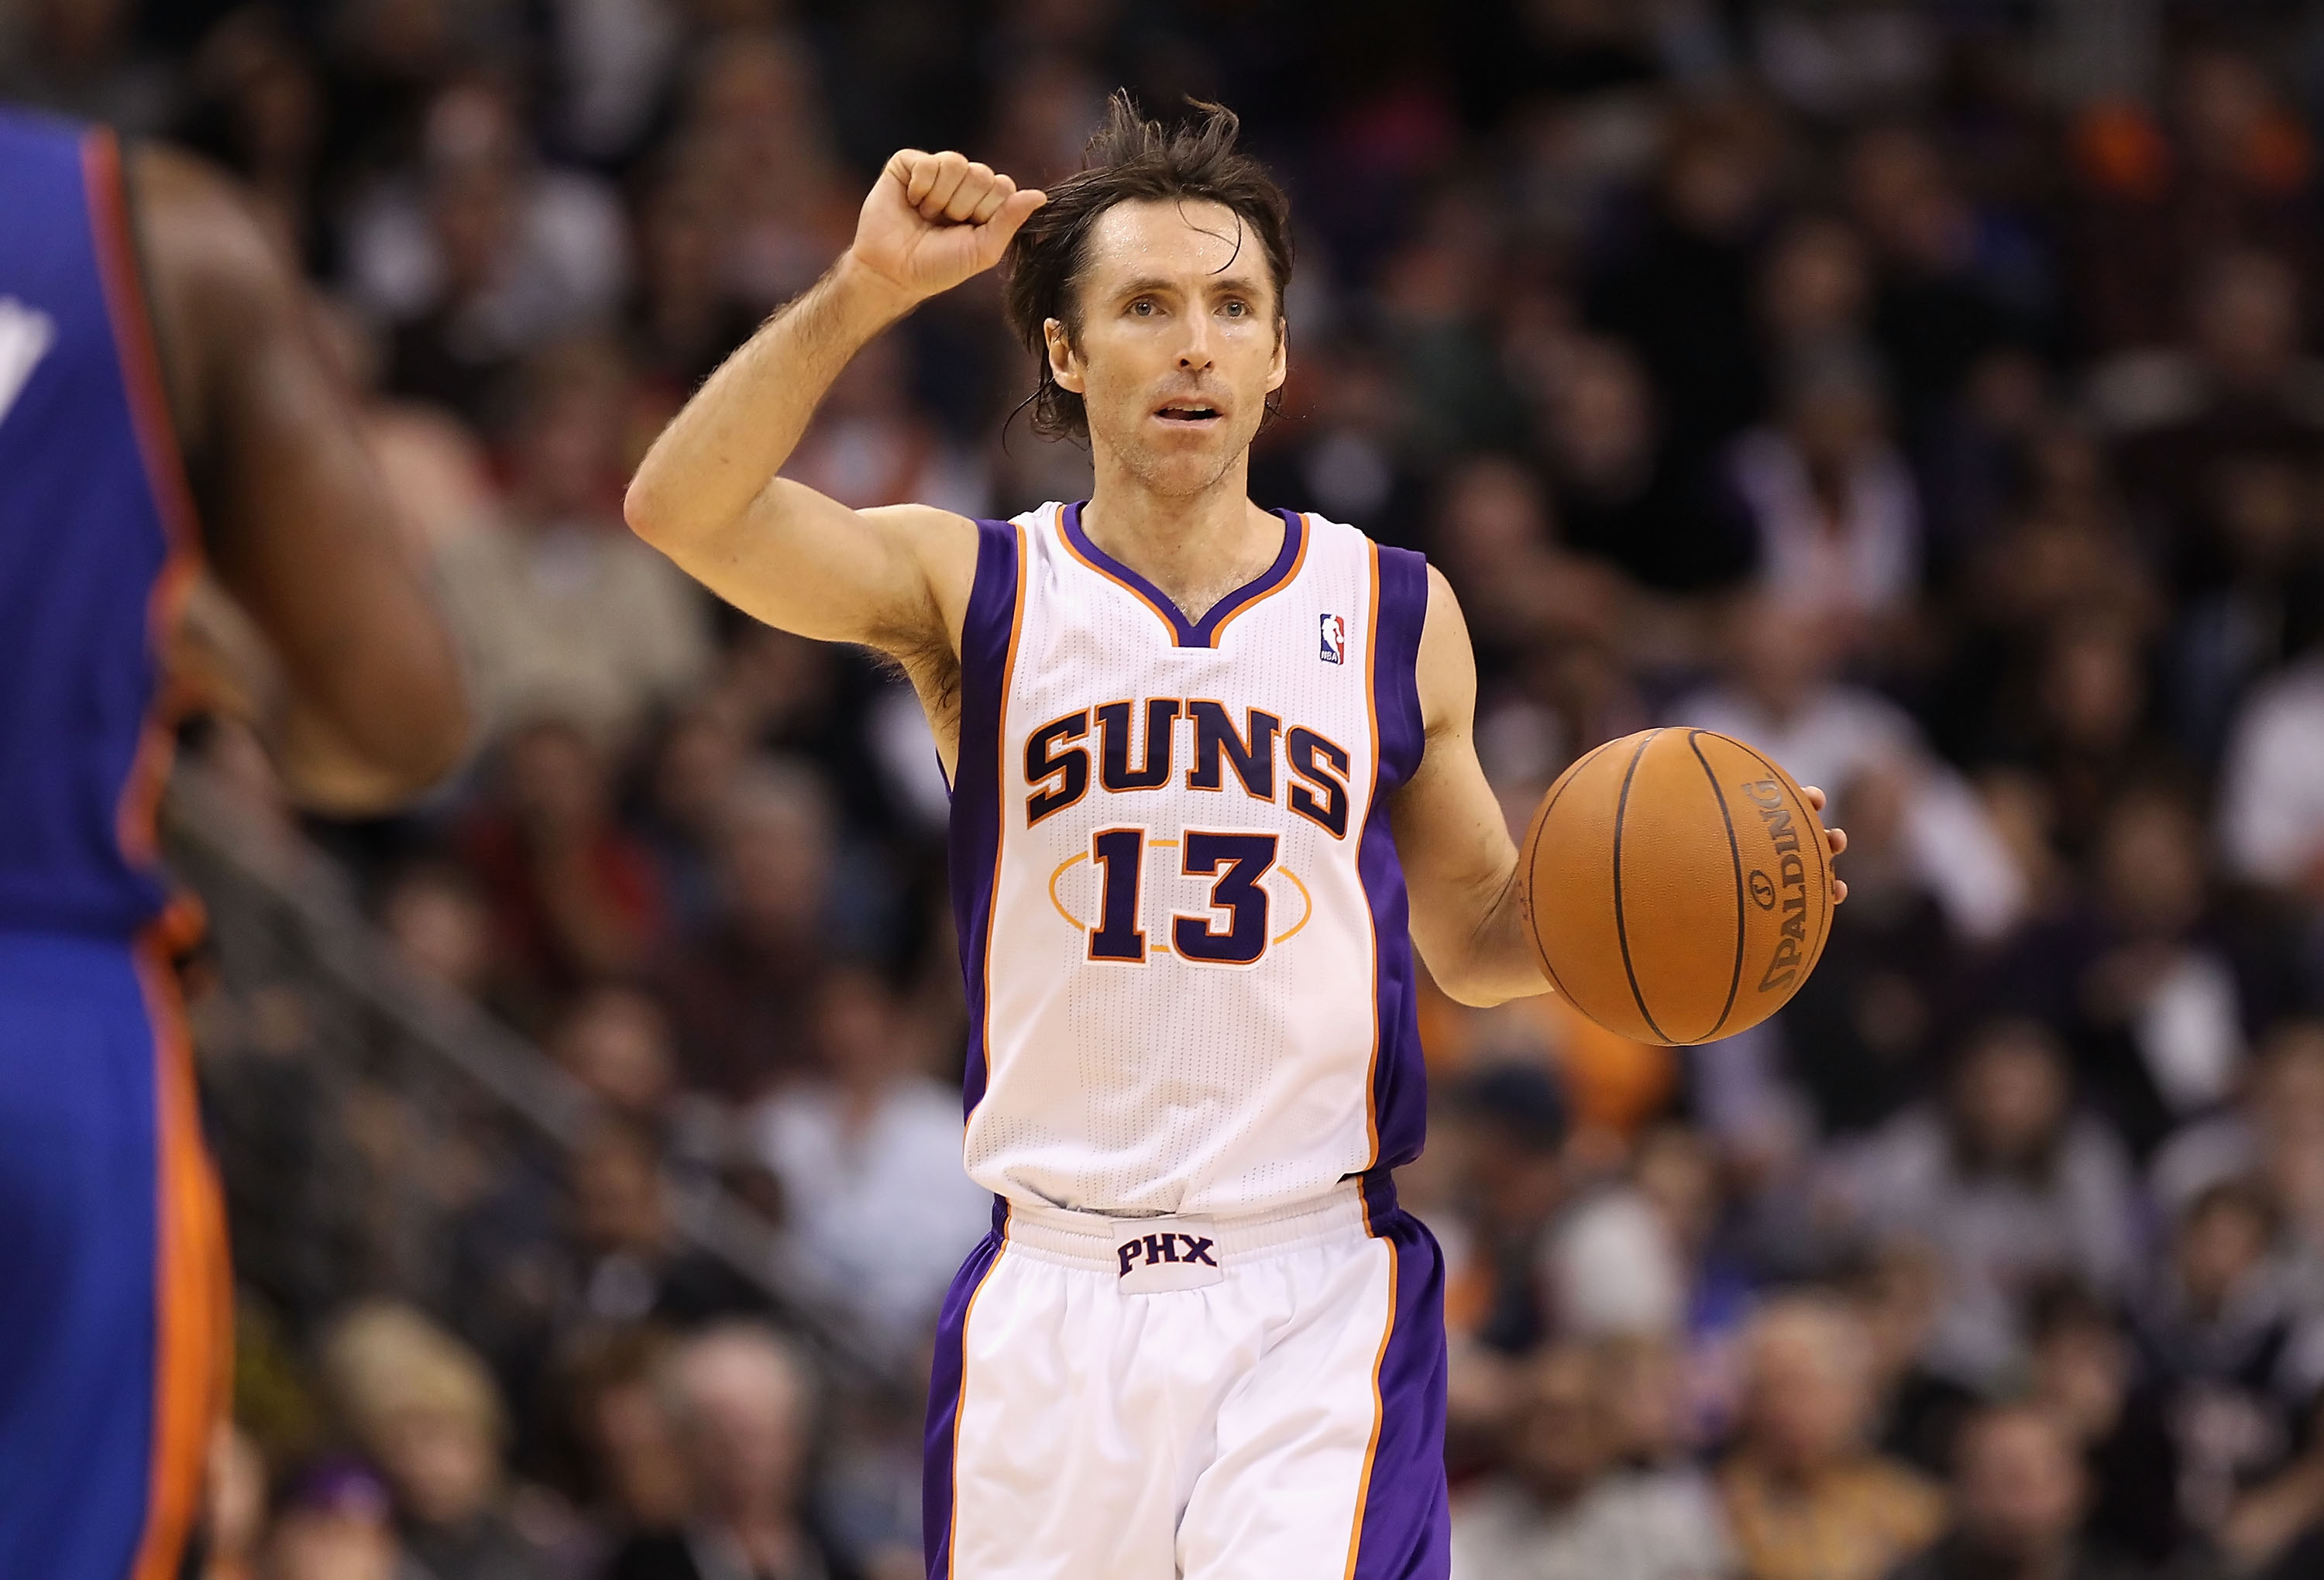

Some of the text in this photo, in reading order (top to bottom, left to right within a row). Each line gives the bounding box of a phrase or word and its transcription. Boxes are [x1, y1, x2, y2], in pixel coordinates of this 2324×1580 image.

[1320, 650, 1338, 662] NBA
[1023, 698, 1350, 840] SUNS
[1088, 828, 1279, 963] 13
[1741, 779, 1807, 993] SPALDING
[1117, 1233, 1218, 1278] PHX
